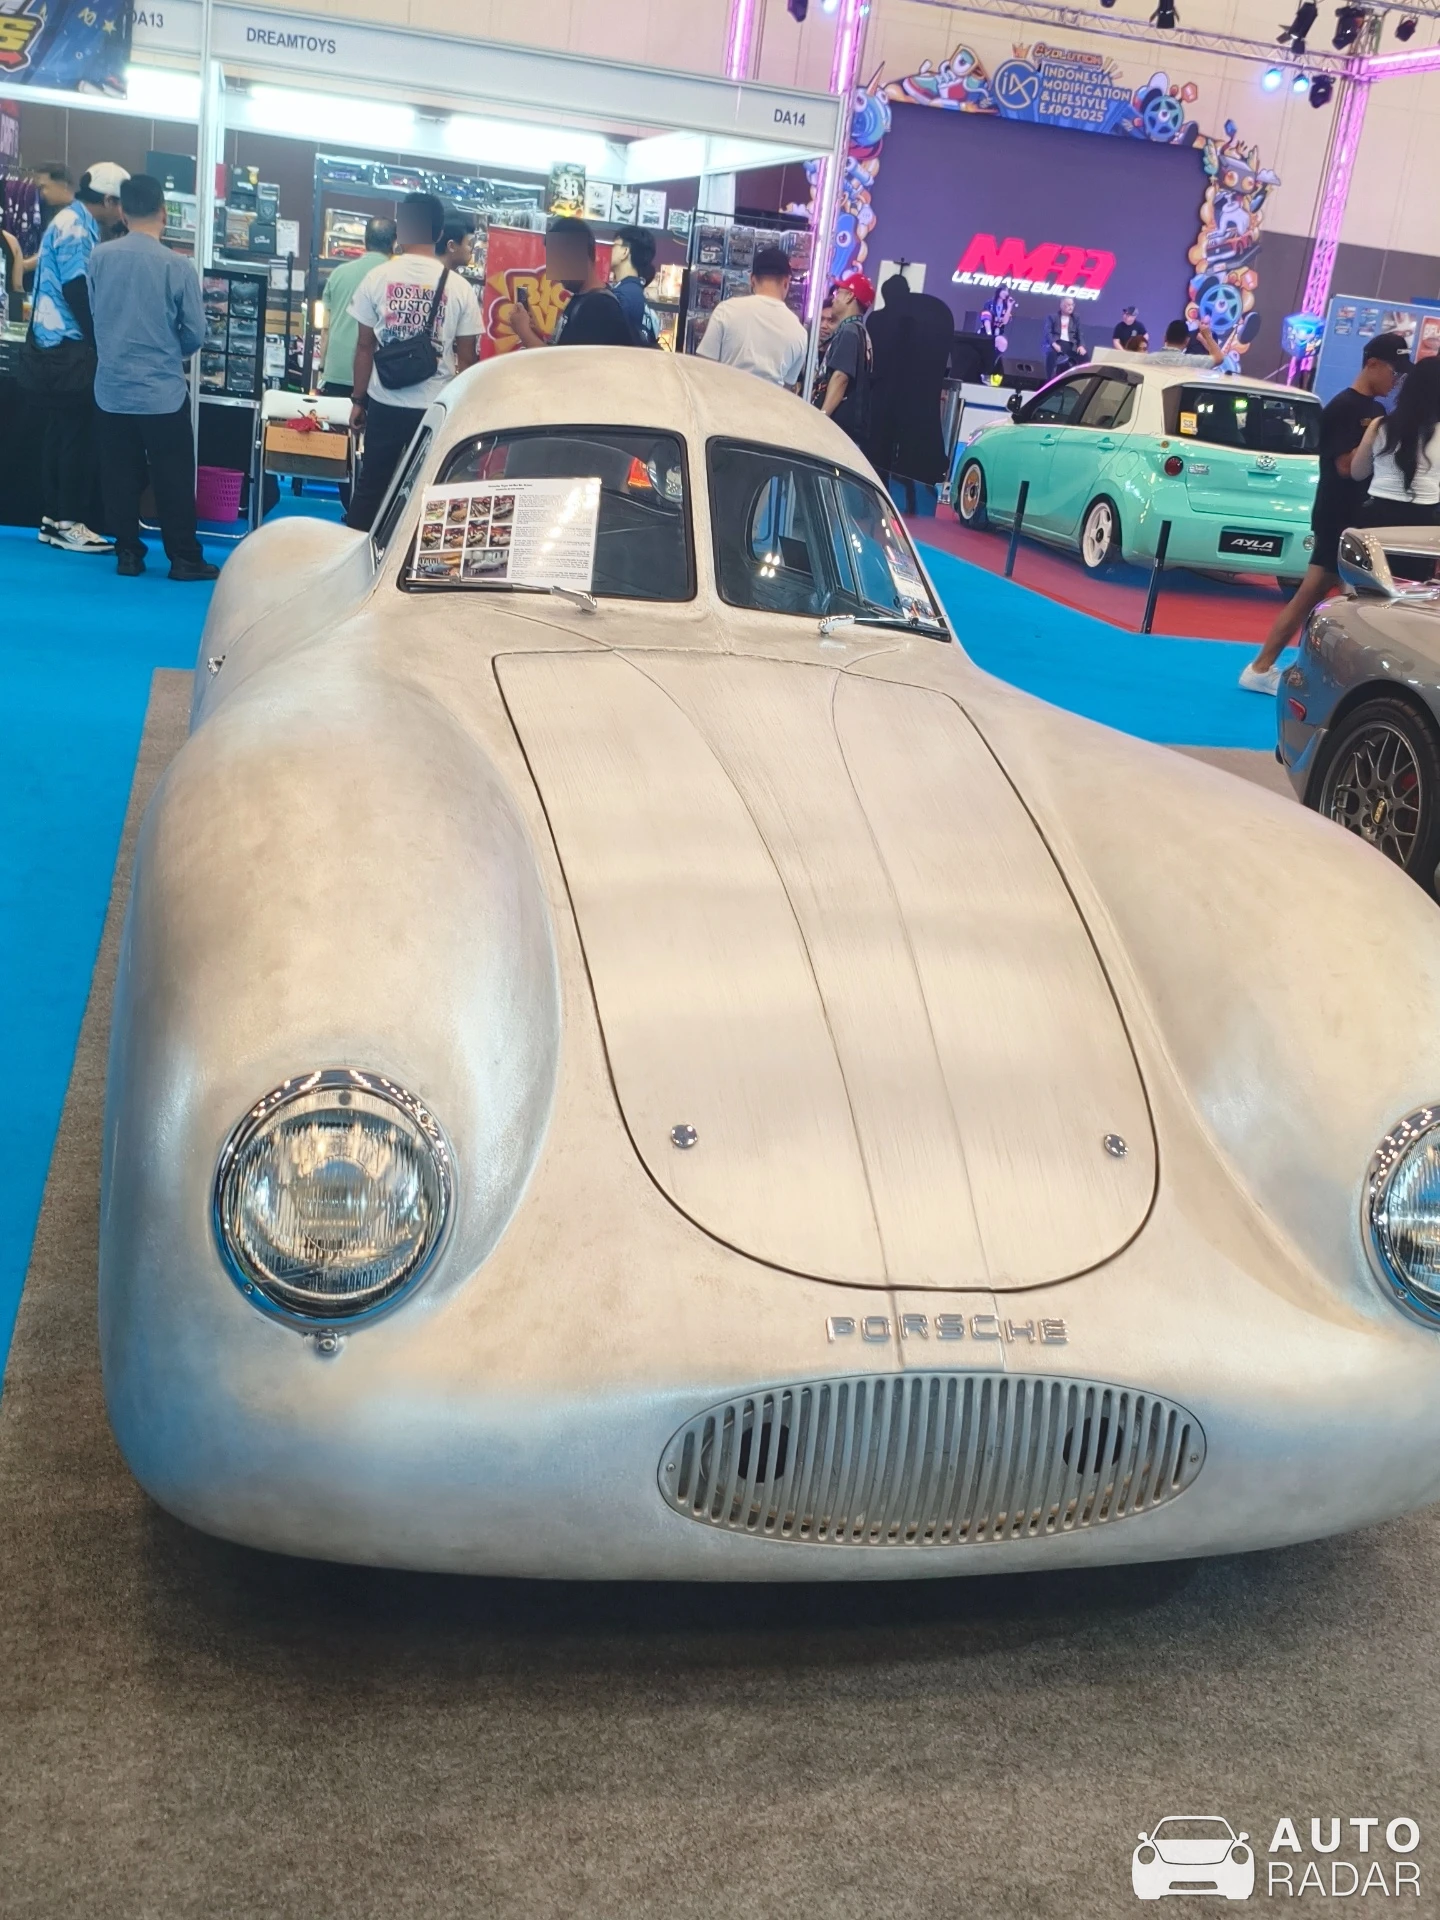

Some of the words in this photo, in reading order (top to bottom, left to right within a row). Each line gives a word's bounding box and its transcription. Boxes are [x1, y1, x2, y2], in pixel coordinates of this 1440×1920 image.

[247, 27, 336, 54] DREAMTOYS
[1044, 65, 1111, 87] INDONESIA
[1040, 90, 1050, 102] &
[1051, 91, 1108, 111] LIFESTYLE
[1042, 80, 1131, 102] MODIFICATION
[774, 108, 806, 128] DA14
[1039, 102, 1072, 117] EXPO
[1072, 107, 1105, 123] 2025
[394, 286, 436, 300] OSAK
[951, 270, 1031, 293] ULTIMATE
[1030, 280, 1101, 301] BUILDER
[1230, 538, 1274, 549] AYLA
[825, 1313, 1069, 1345] PORSCHE
